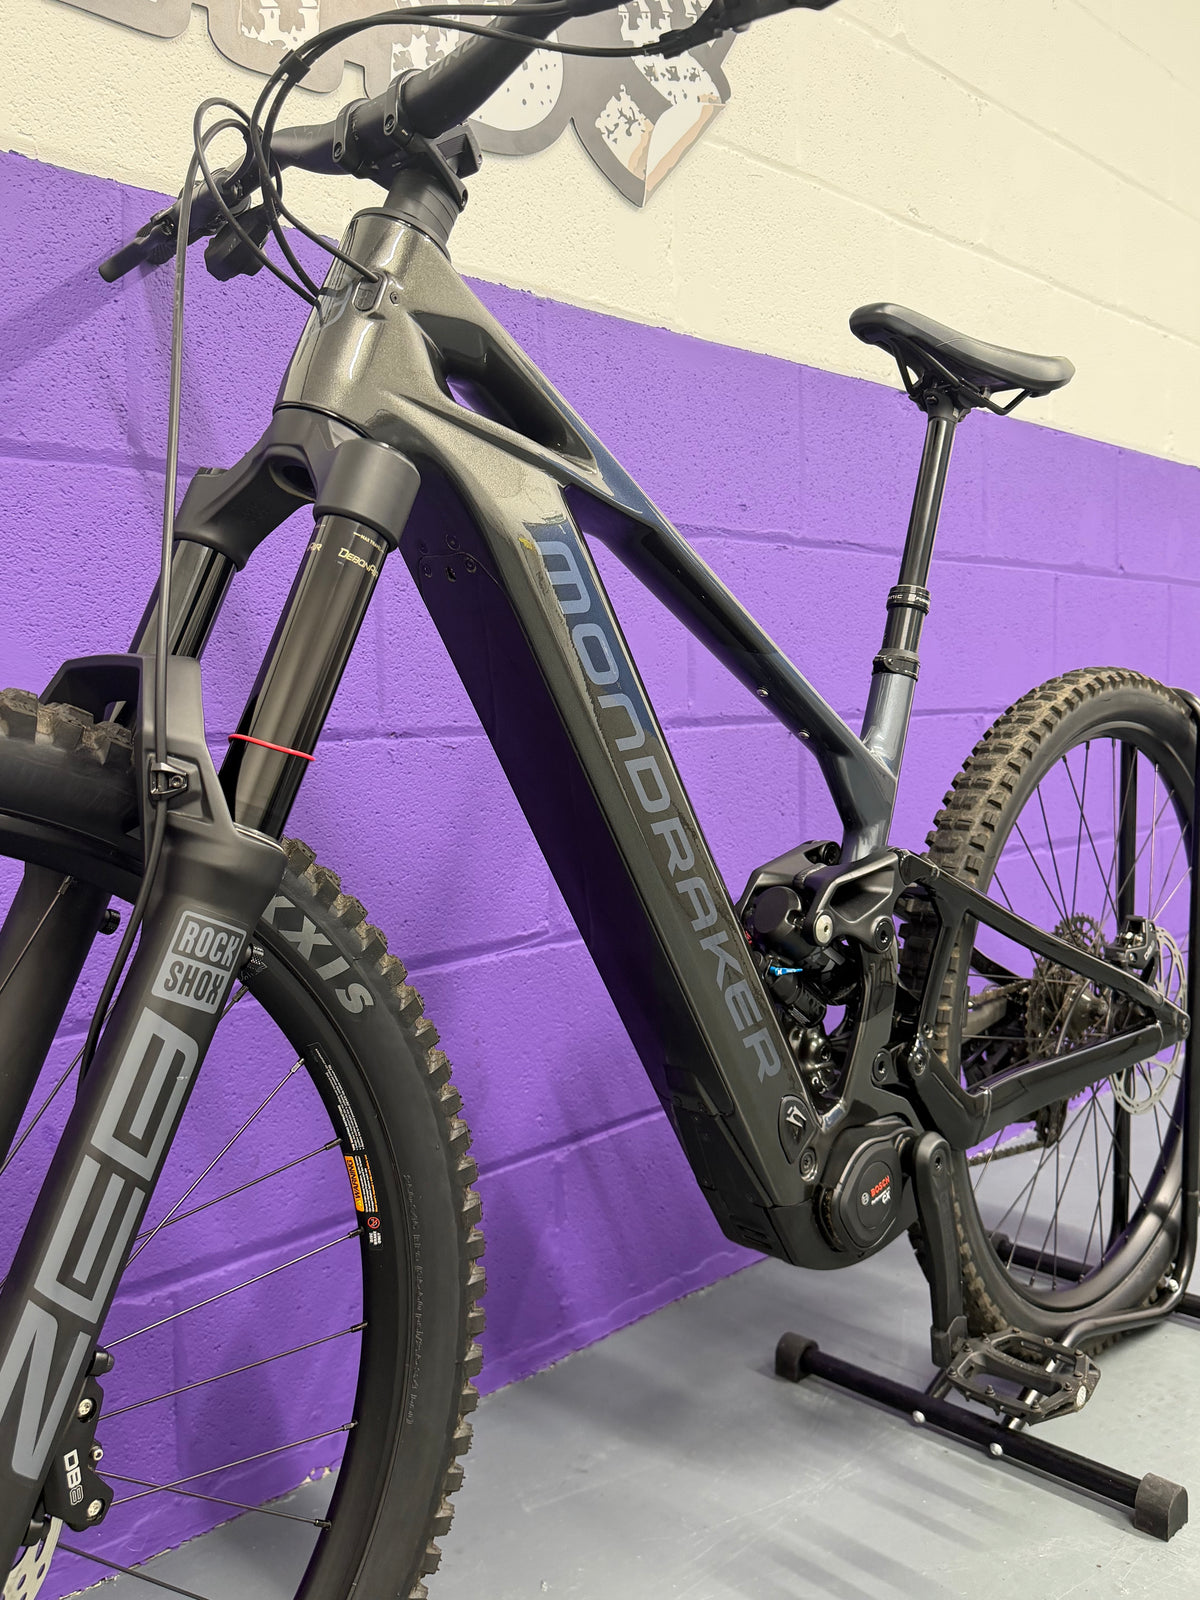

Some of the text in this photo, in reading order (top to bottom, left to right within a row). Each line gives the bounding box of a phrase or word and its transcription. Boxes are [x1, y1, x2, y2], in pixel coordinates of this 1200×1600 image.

[534, 540, 782, 1083] MONDRAKER
[177, 920, 240, 968] ROCK
[163, 960, 225, 1006] SHOX
[346, 1159, 360, 1200] WARNING
[871, 1175, 889, 1197] BOSCH
[0, 1005, 200, 1481] ZEB
[63, 1448, 85, 1506] DB8
